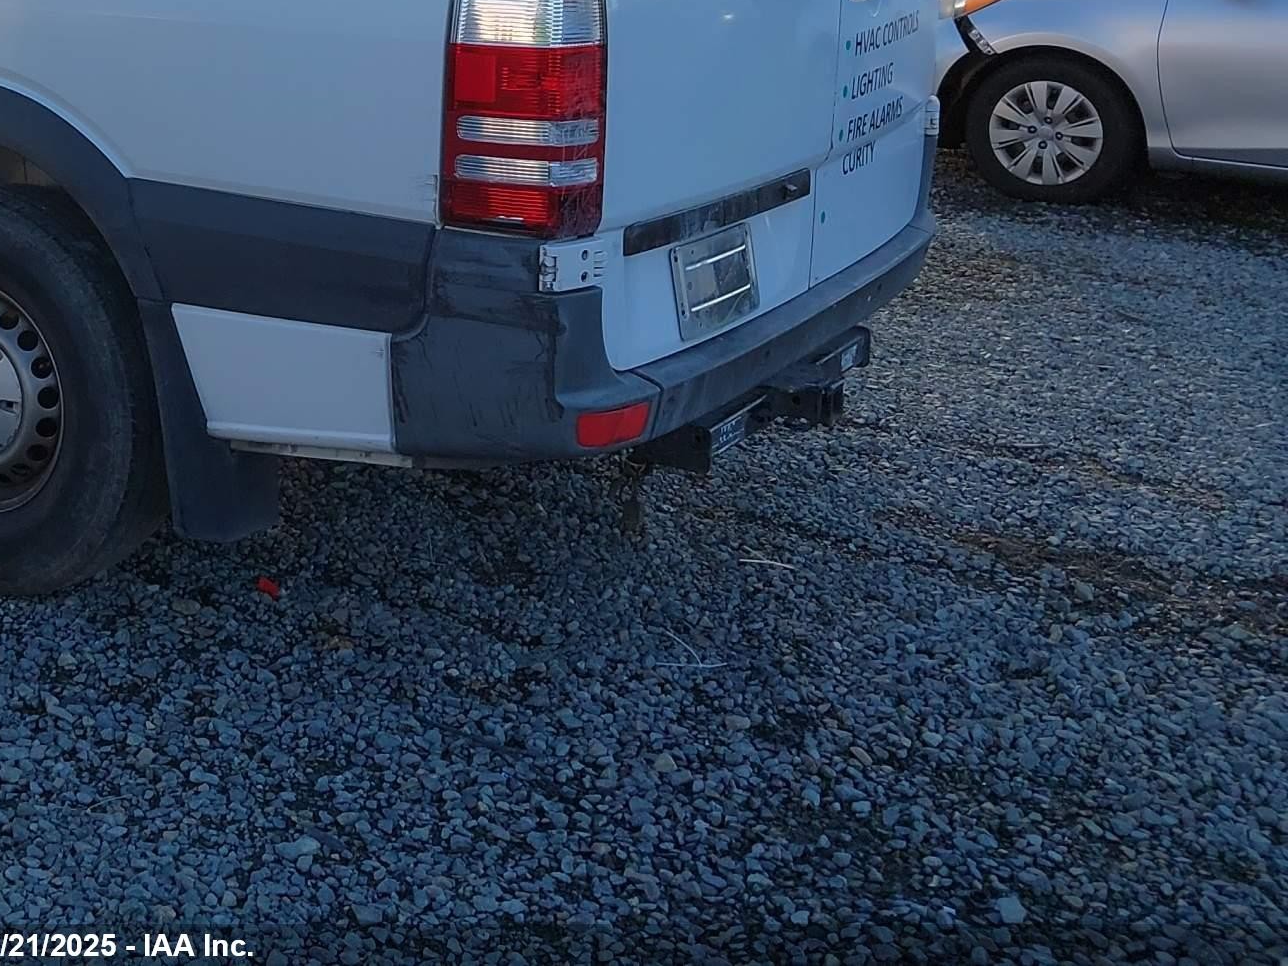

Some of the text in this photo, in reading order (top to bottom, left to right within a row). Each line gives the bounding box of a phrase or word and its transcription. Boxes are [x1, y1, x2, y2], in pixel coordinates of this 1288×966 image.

[854, 10, 920, 56] HVAC CONTROLS
[851, 62, 894, 100] LIGHTING
[846, 96, 904, 143] FIRE ALARMS
